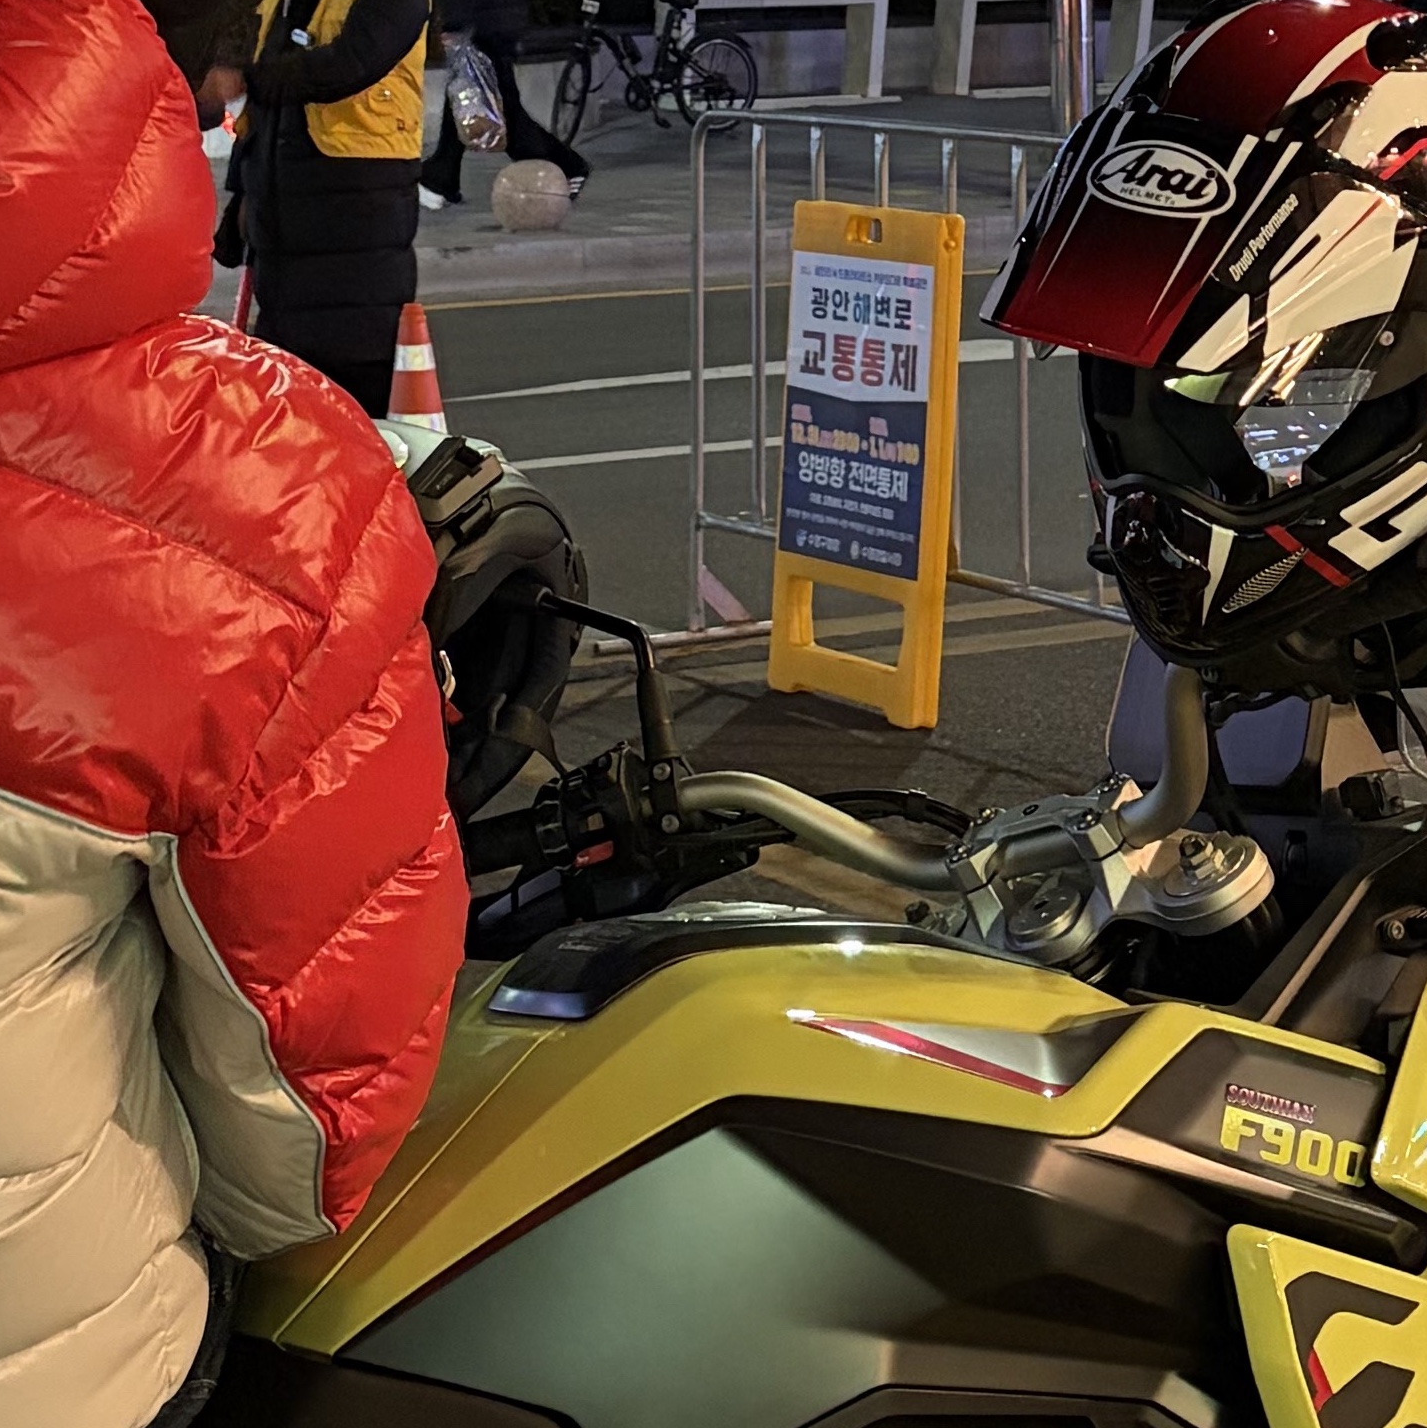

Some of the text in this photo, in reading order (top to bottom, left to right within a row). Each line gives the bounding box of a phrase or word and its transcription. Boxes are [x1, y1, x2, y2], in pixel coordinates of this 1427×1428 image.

[1095, 149, 1218, 200] Arai
[1228, 244, 1258, 283] Drudi
[811, 287, 912, 330] 광안해변로
[800, 330, 918, 392] 교통통제
[798, 451, 909, 502] 양방향 전면통제
[1220, 1104, 1367, 1189] F900
